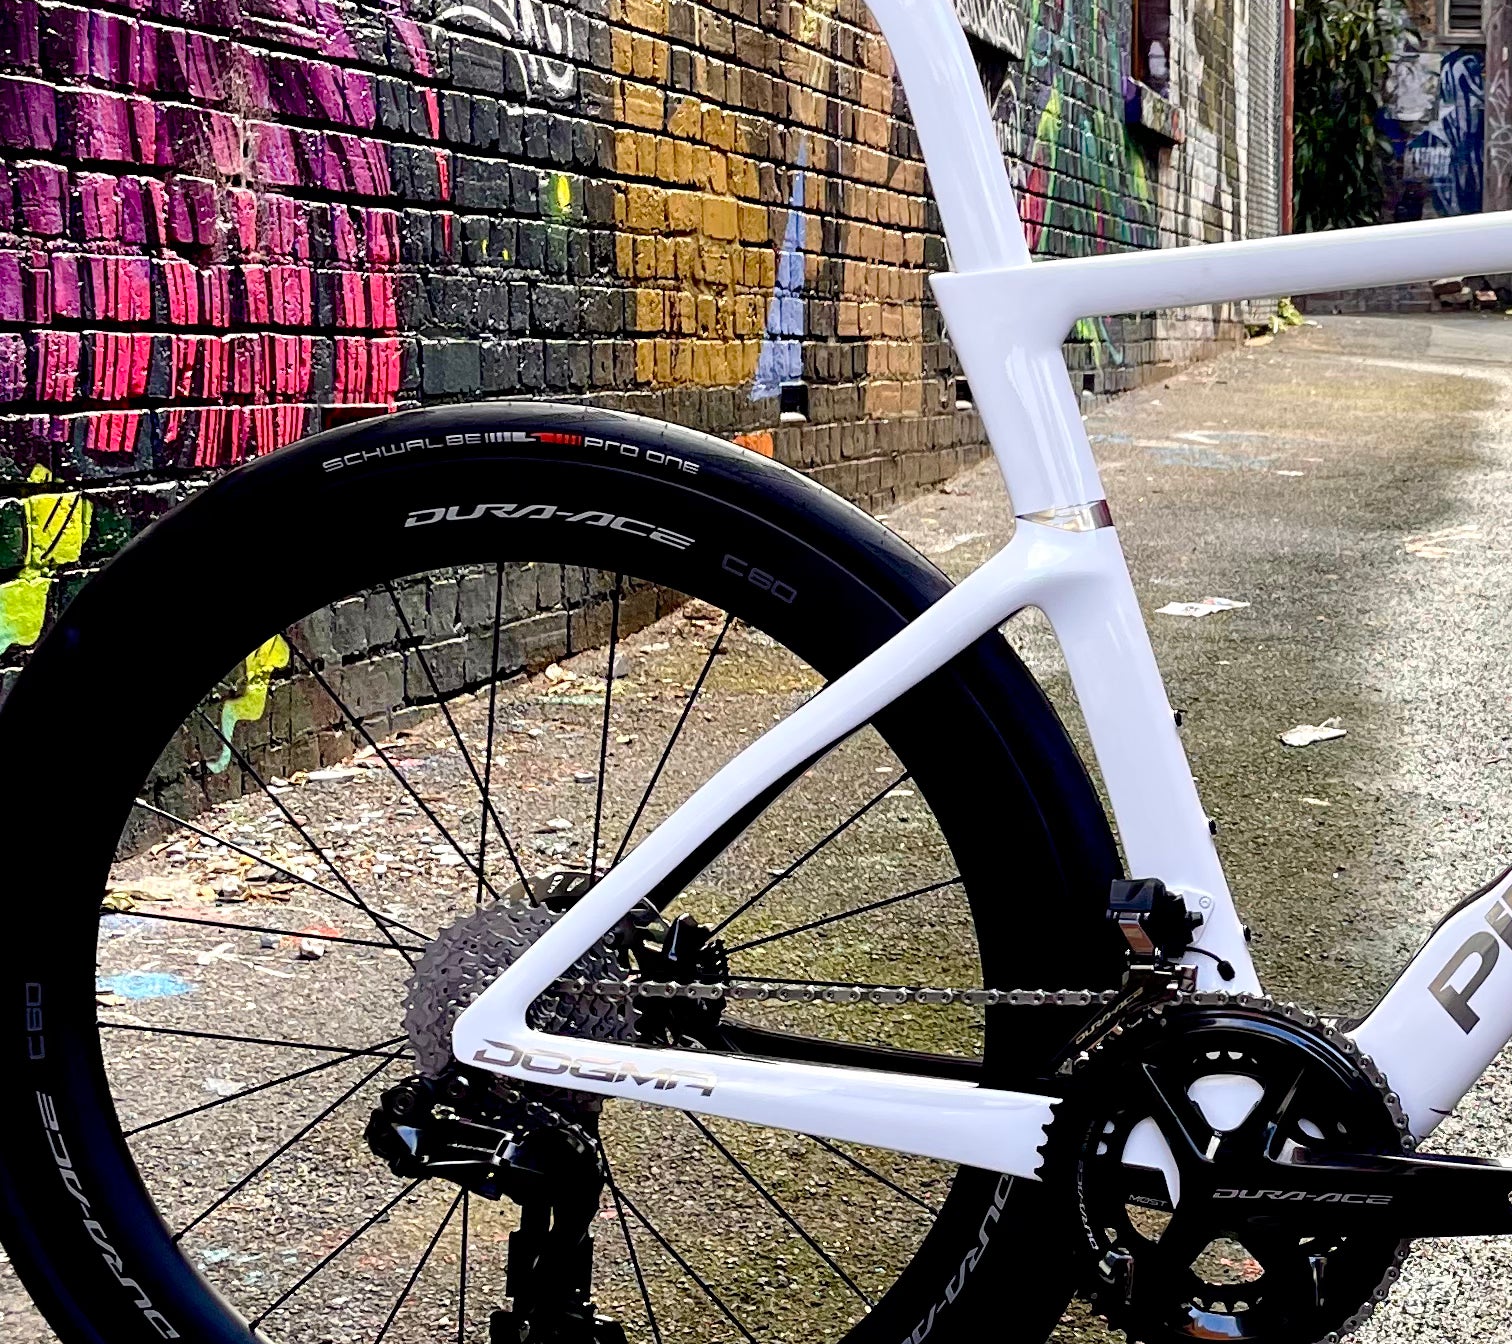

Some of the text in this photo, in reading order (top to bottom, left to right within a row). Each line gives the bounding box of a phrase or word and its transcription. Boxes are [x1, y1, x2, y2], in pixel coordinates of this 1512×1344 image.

[322, 433, 482, 473] SCHWALBE
[404, 503, 797, 604] DURA-ACE C60
[472, 1038, 718, 1097] DOGMA
[35, 1090, 181, 1339] DURA-ACE
[1128, 1193, 1168, 1208] MOST
[1213, 1188, 1393, 1205] DURA-ACE
